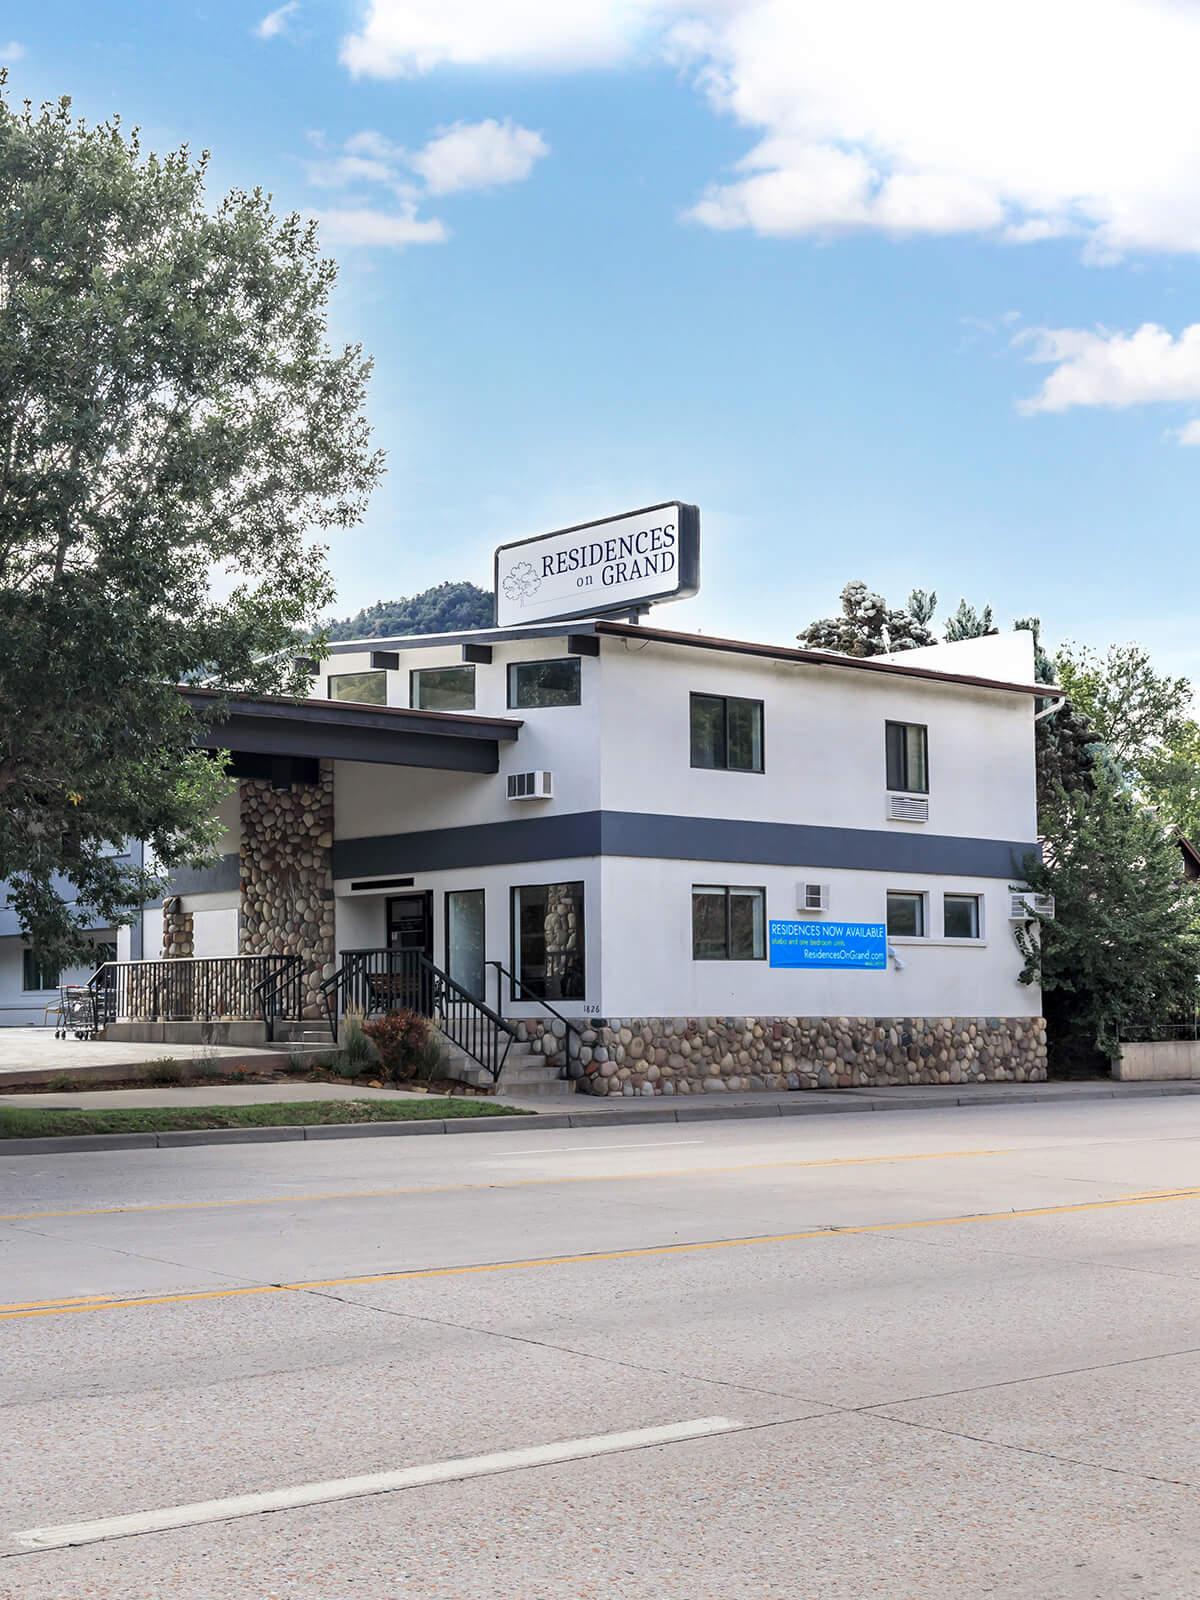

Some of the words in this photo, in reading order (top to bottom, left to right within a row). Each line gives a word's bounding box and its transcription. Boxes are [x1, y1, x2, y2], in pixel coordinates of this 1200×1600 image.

[541, 524, 675, 578] RESIDENCES
[576, 575, 593, 588] on
[601, 551, 675, 586] GRAND
[771, 923, 821, 937] RESIDENCES
[822, 925, 843, 937] NOW
[845, 926, 884, 938] AVAILABLE
[803, 948, 884, 960] ResidencesOnGrand.com
[583, 1004, 600, 1014] 1826
